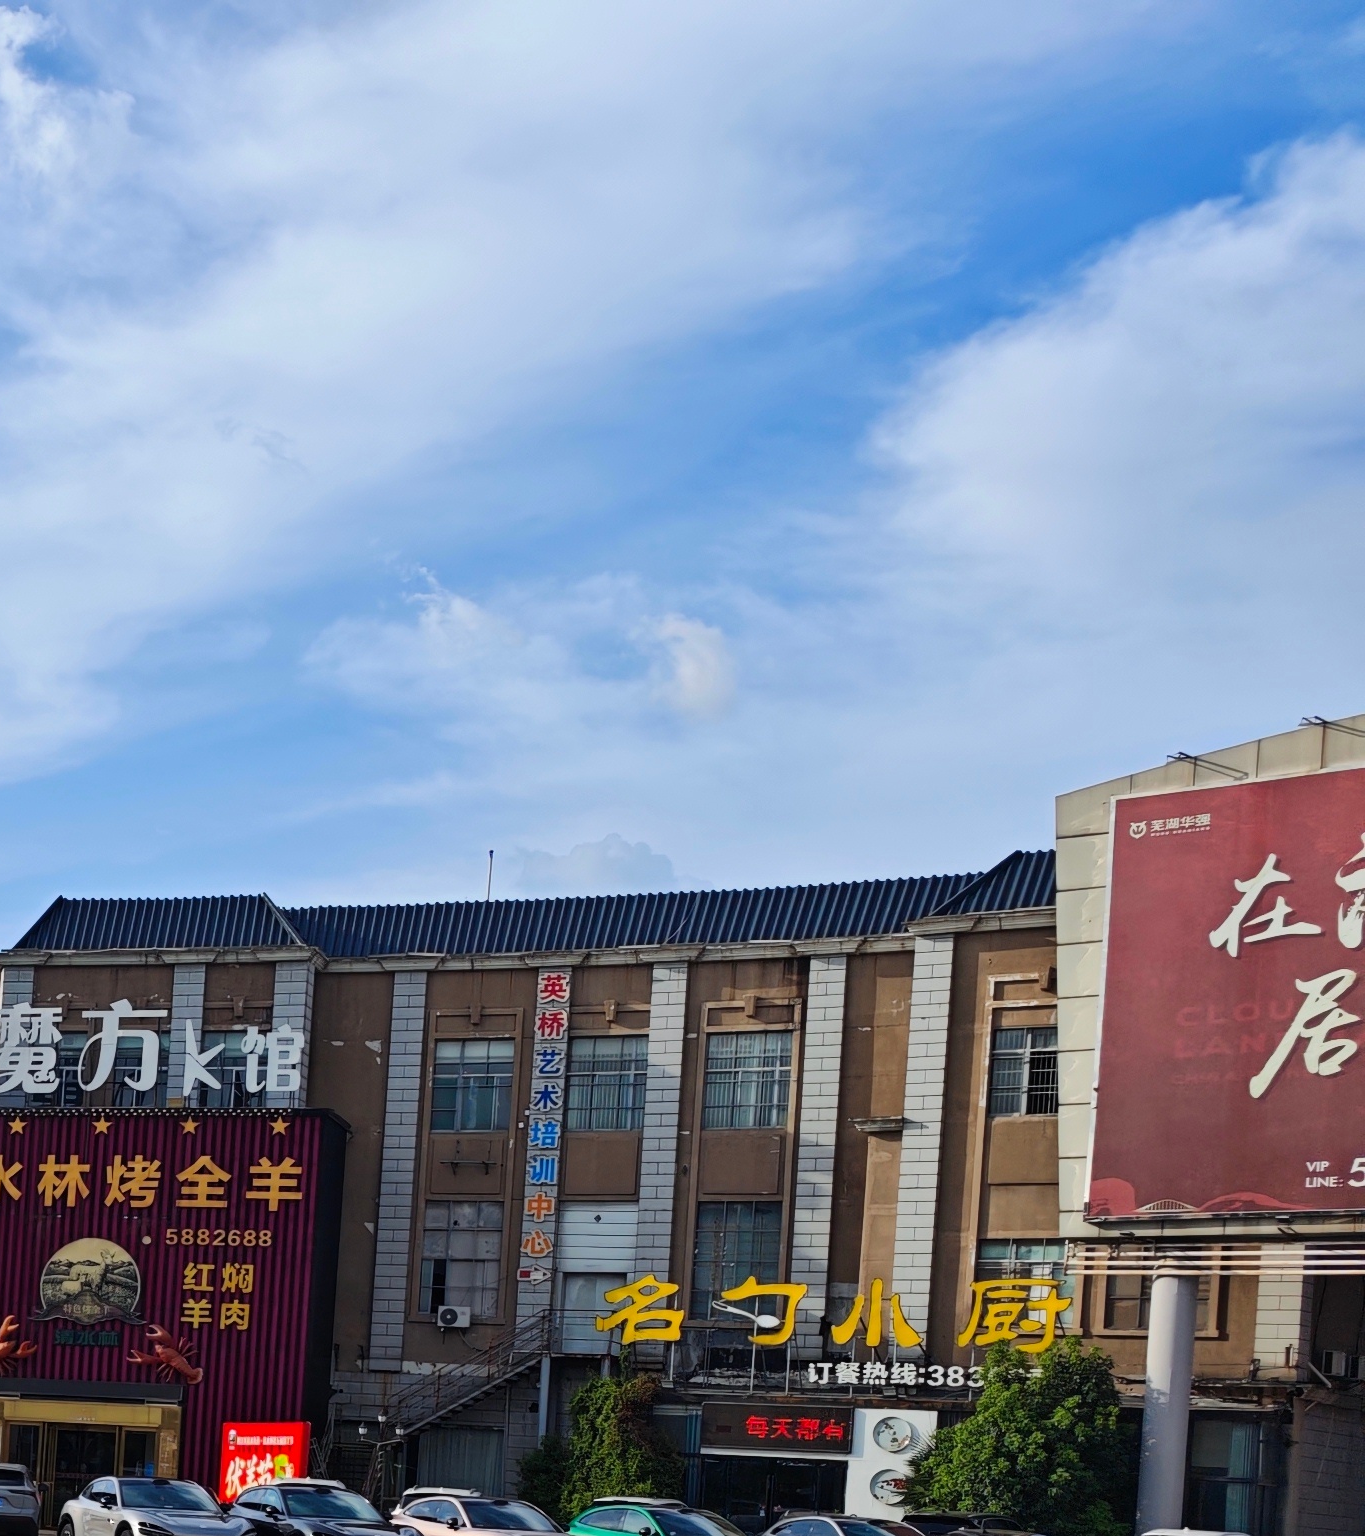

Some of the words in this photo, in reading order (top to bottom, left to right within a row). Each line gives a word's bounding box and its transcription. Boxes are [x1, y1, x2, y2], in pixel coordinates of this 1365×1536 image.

[1150, 813, 1211, 832] 芜湖华强
[1249, 968, 1361, 1099] 居
[521, 973, 569, 1257] 英桥艺术培训中心
[1306, 1161, 1330, 1173] VIP
[165, 1228, 272, 1247] 5882688
[182, 1261, 254, 1294] 红焖
[180, 1298, 251, 1331] 羊肉
[596, 1274, 1072, 1353] 名勺小厨
[55, 1329, 120, 1346] 清水林
[745, 1414, 847, 1441] 每天都有
